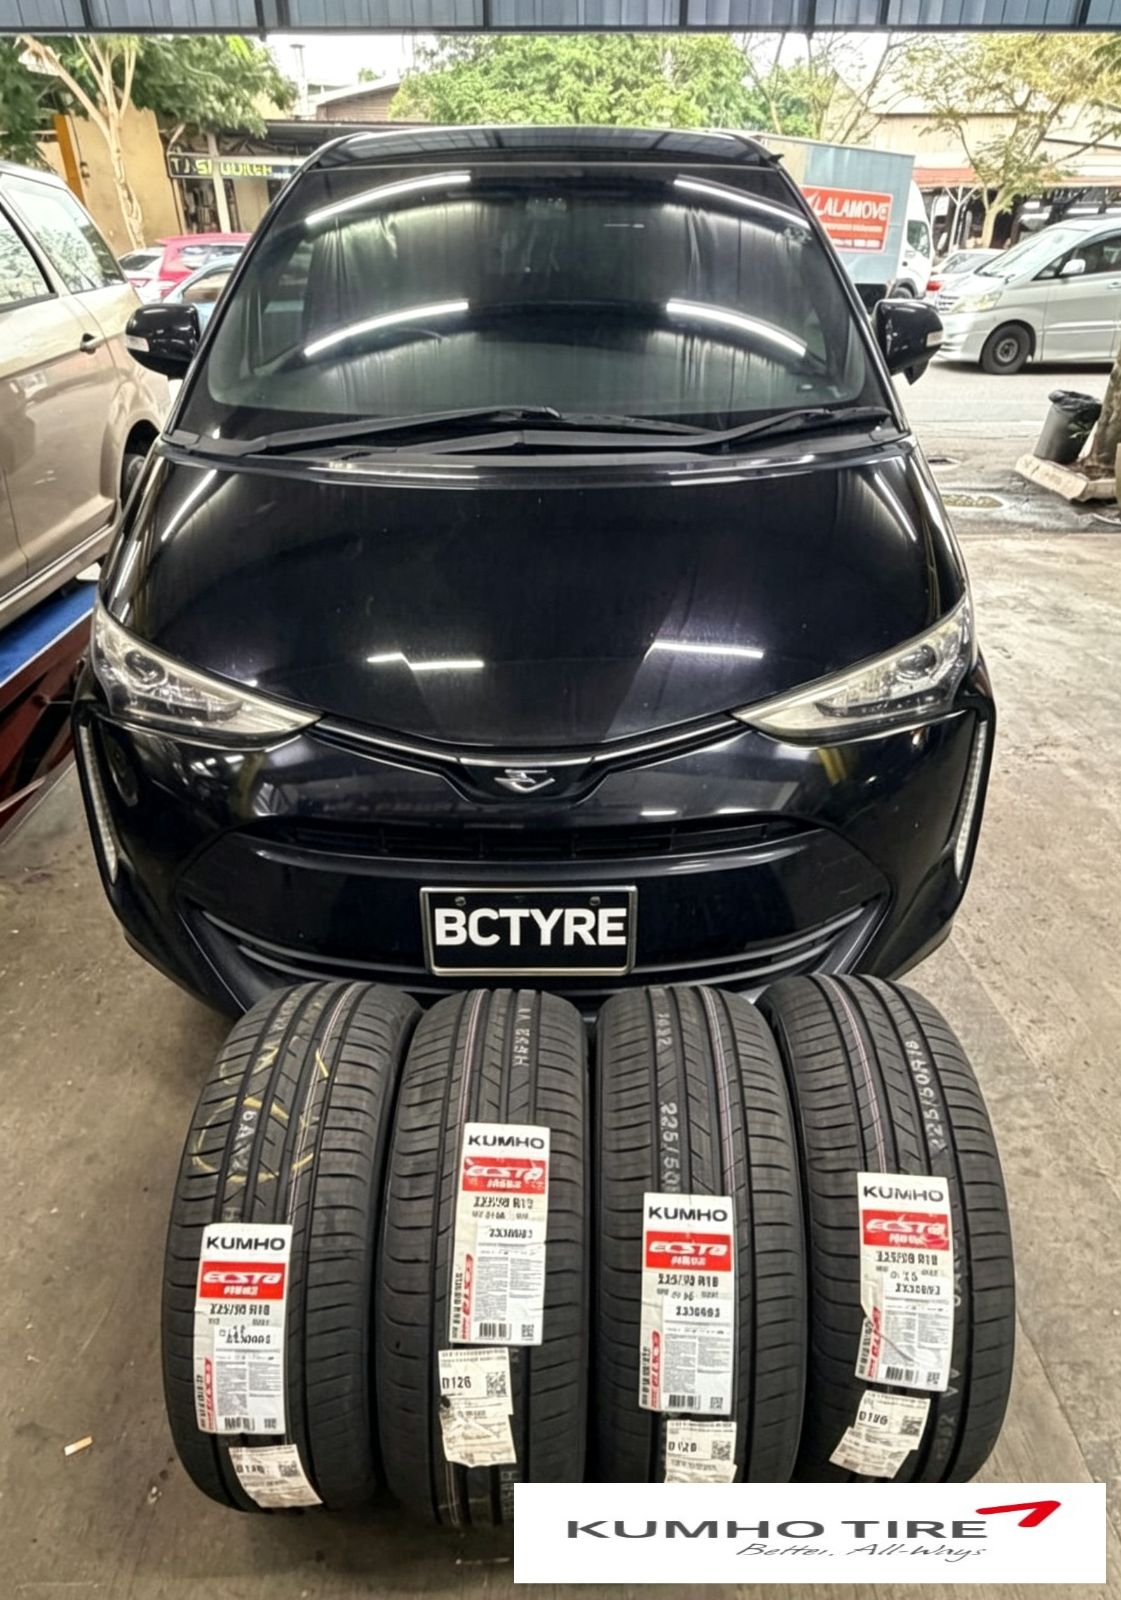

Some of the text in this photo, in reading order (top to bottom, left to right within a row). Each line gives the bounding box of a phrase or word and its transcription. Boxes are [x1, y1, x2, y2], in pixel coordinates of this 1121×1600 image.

[813, 195, 890, 221] LALAMOVE
[434, 907, 628, 947] BCTYRE
[467, 1134, 546, 1150] KUMHO
[862, 1184, 945, 1203] KUMHO
[647, 1205, 729, 1223] KUMHO
[206, 1235, 287, 1251] KUMHO
